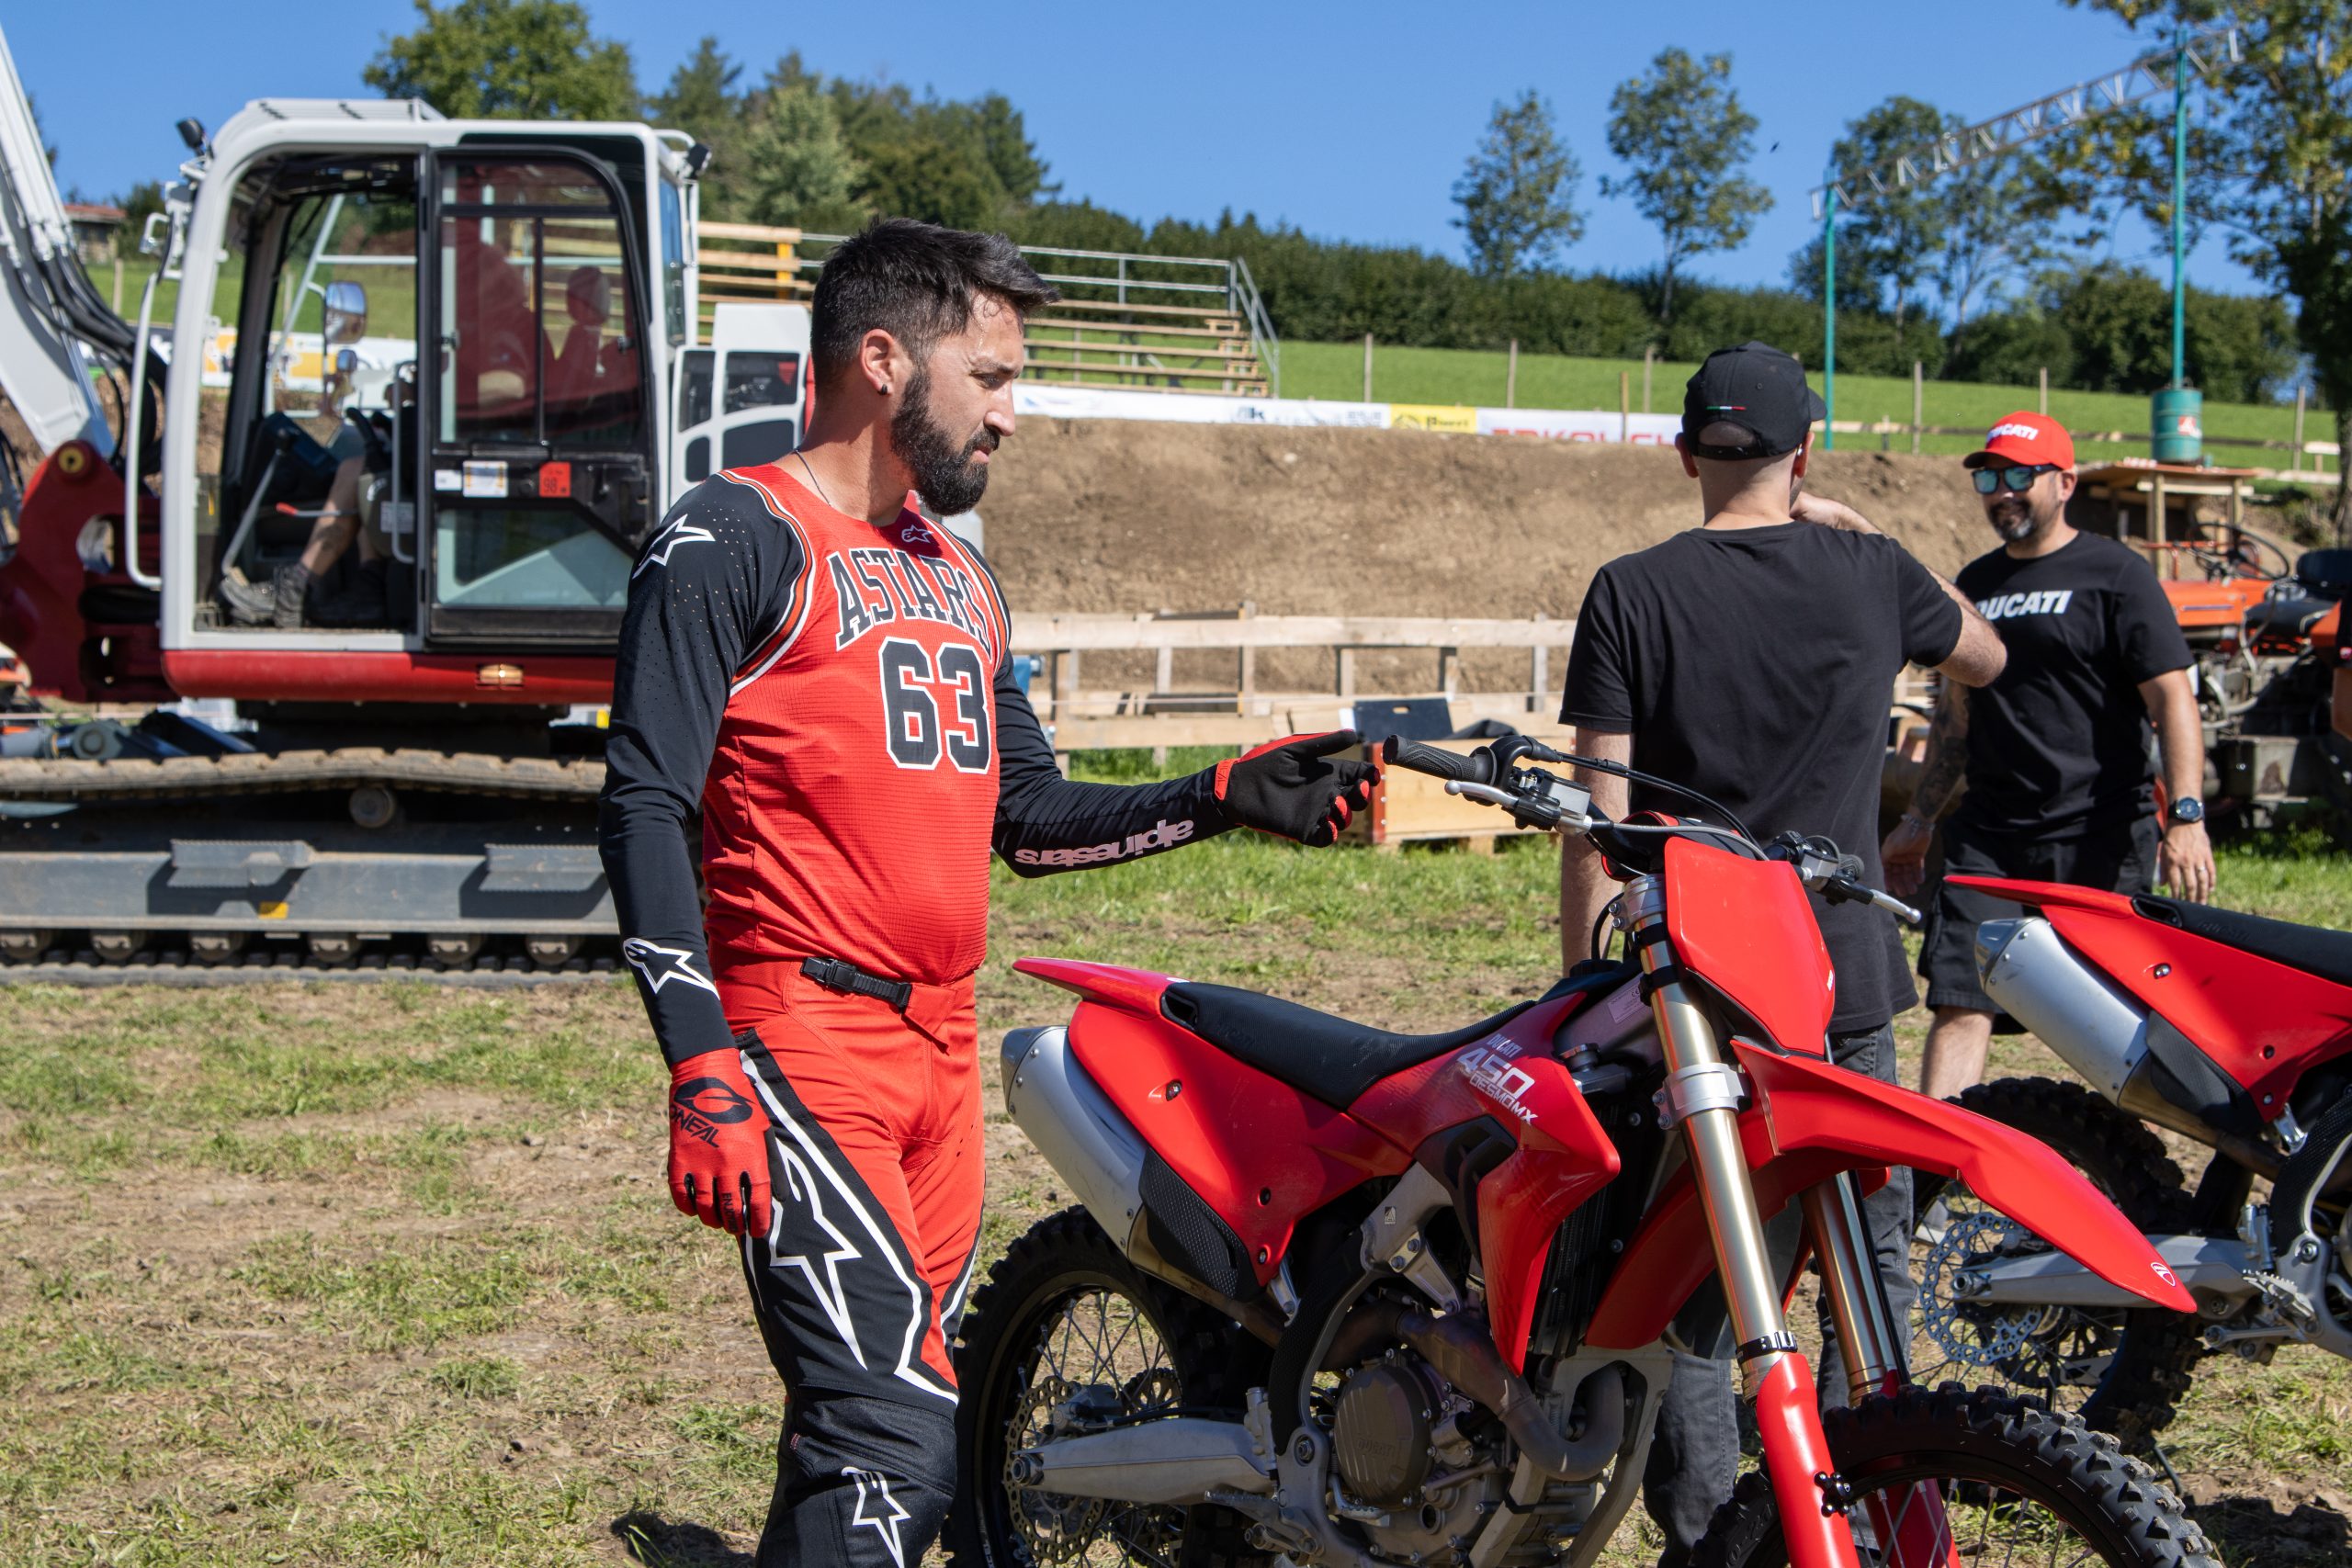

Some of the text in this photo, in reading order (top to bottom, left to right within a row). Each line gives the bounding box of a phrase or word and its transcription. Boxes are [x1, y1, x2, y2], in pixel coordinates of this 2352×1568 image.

[826, 547, 992, 664] ASTARS
[878, 637, 991, 774] 63
[1014, 819, 1194, 867] alpinestars
[1487, 1033, 1522, 1058] DUCATI
[1456, 1047, 1535, 1100] 450
